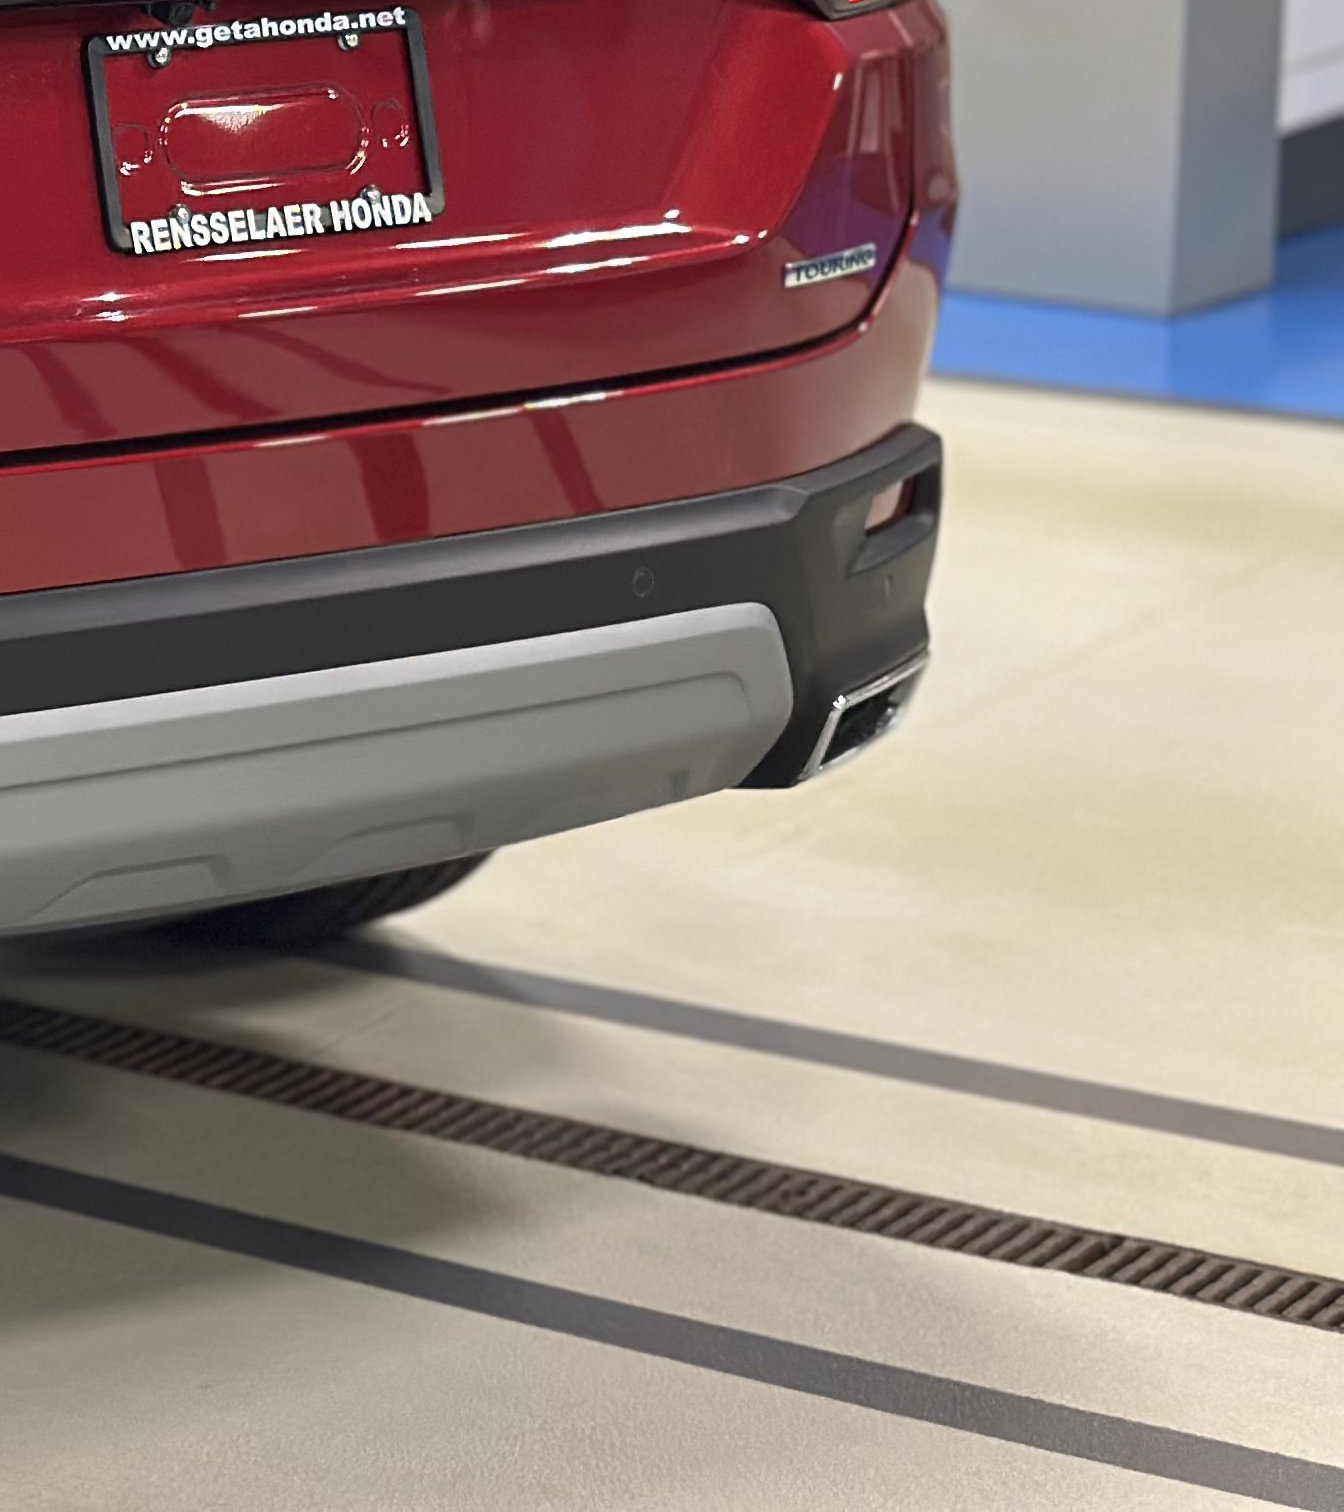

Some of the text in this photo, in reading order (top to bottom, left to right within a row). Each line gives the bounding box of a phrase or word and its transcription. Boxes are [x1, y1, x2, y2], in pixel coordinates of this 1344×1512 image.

[106, 6, 407, 49] www.getahonda.net
[130, 192, 433, 255] RENSSELAER HONDA
[795, 249, 874, 282] TOURING
